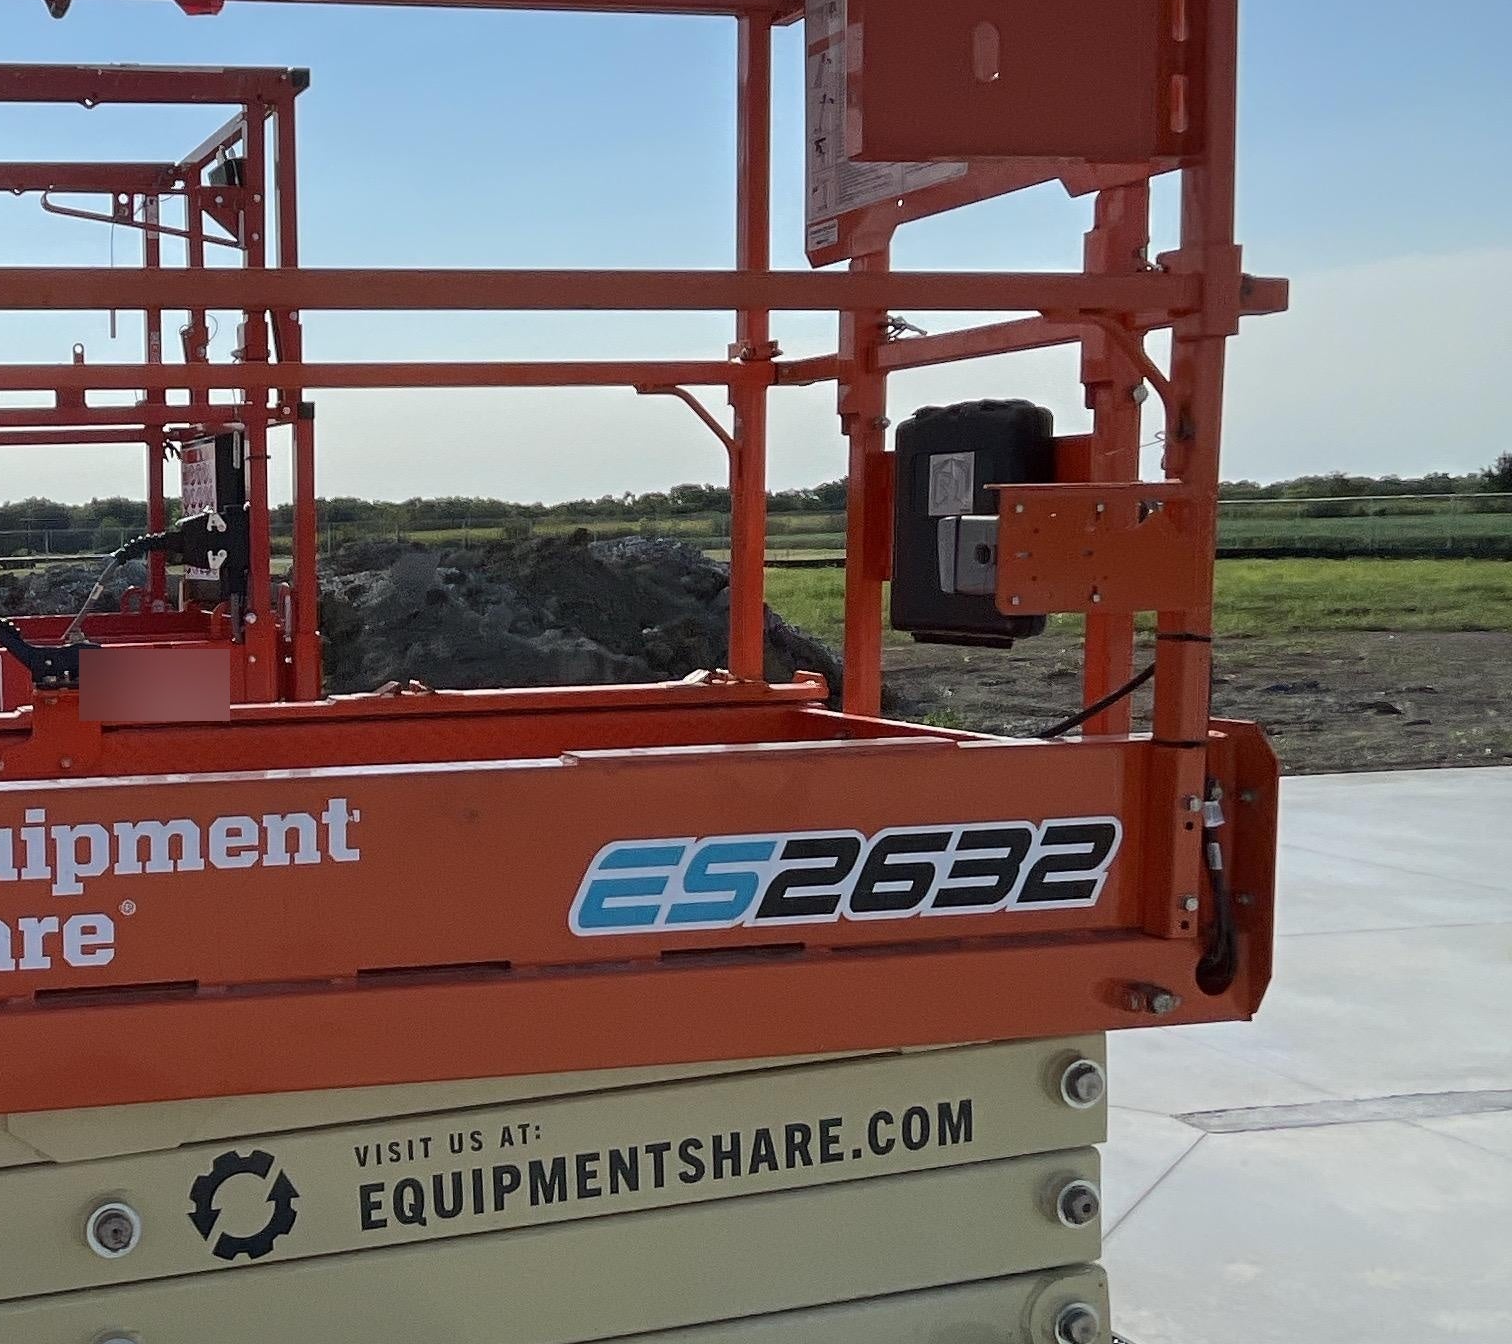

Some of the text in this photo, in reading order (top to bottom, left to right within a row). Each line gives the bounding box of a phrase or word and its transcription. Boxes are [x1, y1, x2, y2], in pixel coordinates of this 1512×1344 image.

[569, 816, 1122, 936] ES2632
[354, 1123, 544, 1168] VISIT US AT:
[358, 1099, 975, 1232] EQUIPMENTSHARE.COM
